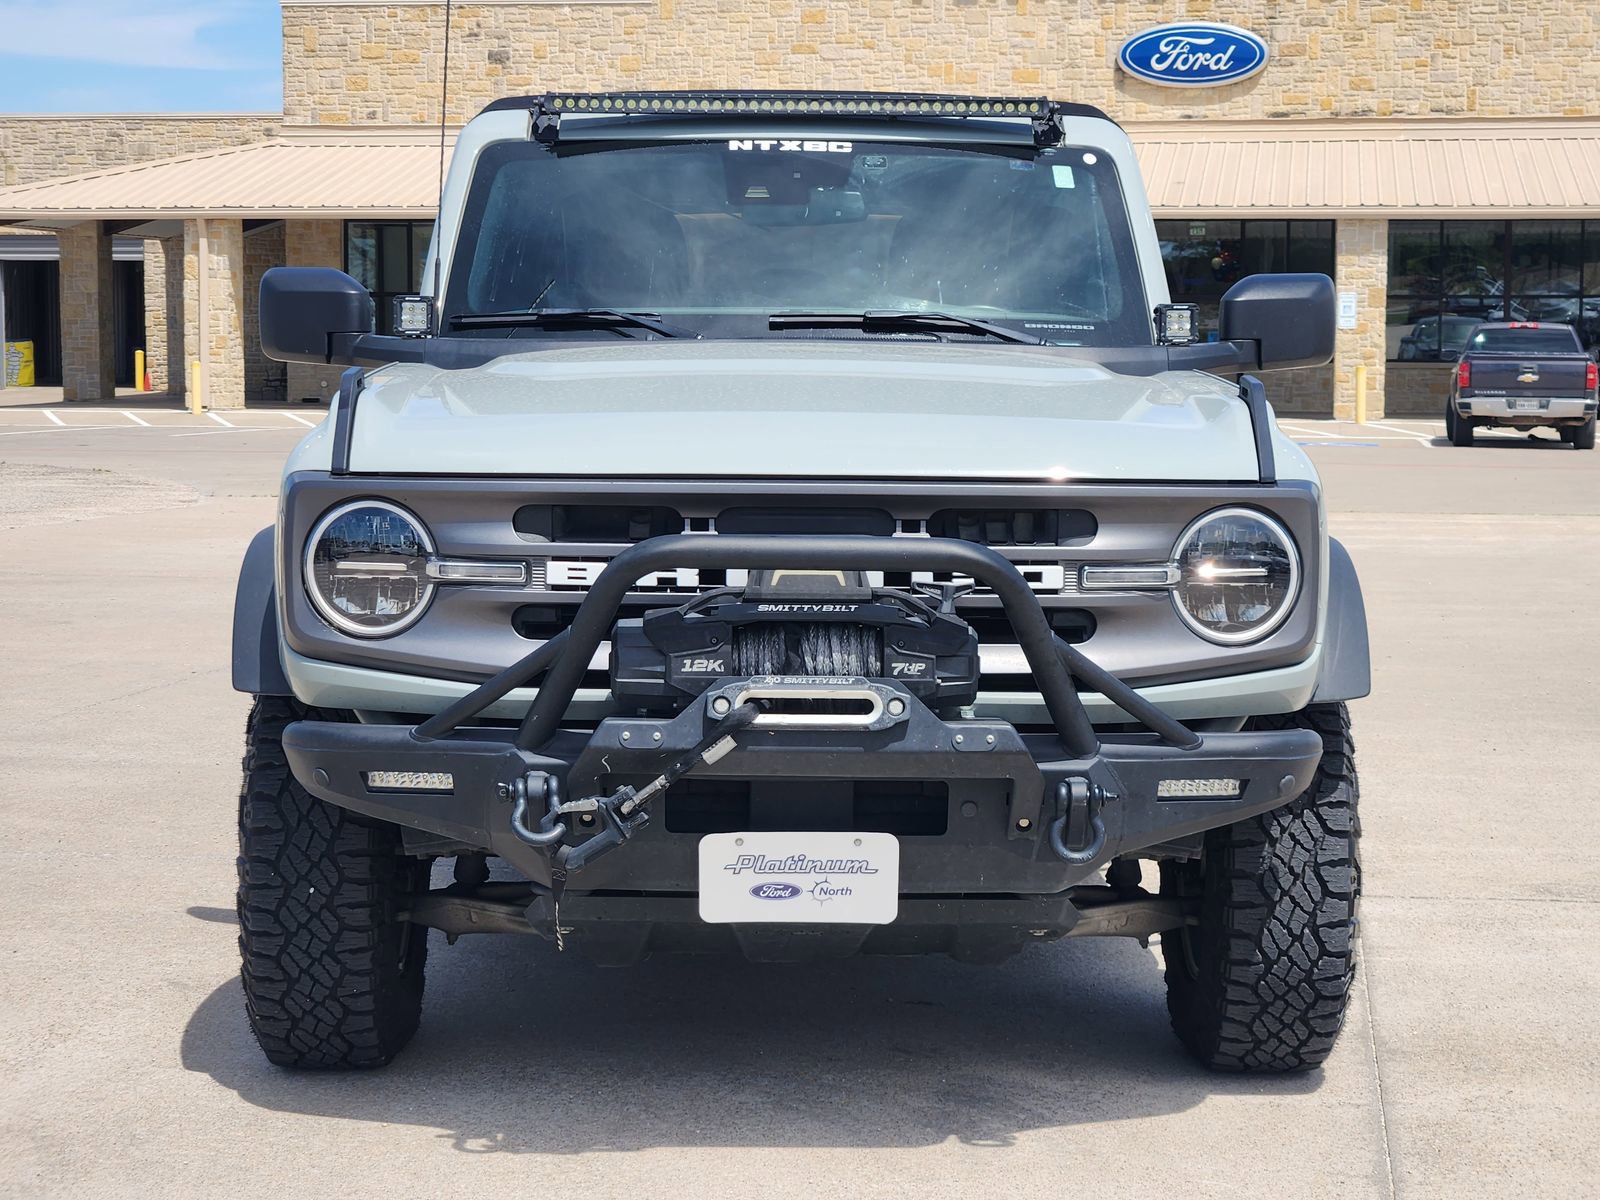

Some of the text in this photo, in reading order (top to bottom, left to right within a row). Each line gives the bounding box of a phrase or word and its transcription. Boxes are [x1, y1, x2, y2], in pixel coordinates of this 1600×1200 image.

[1150, 36, 1236, 71] Ford
[728, 139, 853, 153] NTXBC
[756, 604, 859, 612] SMITTYBILT
[783, 677, 856, 685] SMITTYBILT
[723, 853, 879, 875] Platinum
[759, 884, 853, 898] Ford North
